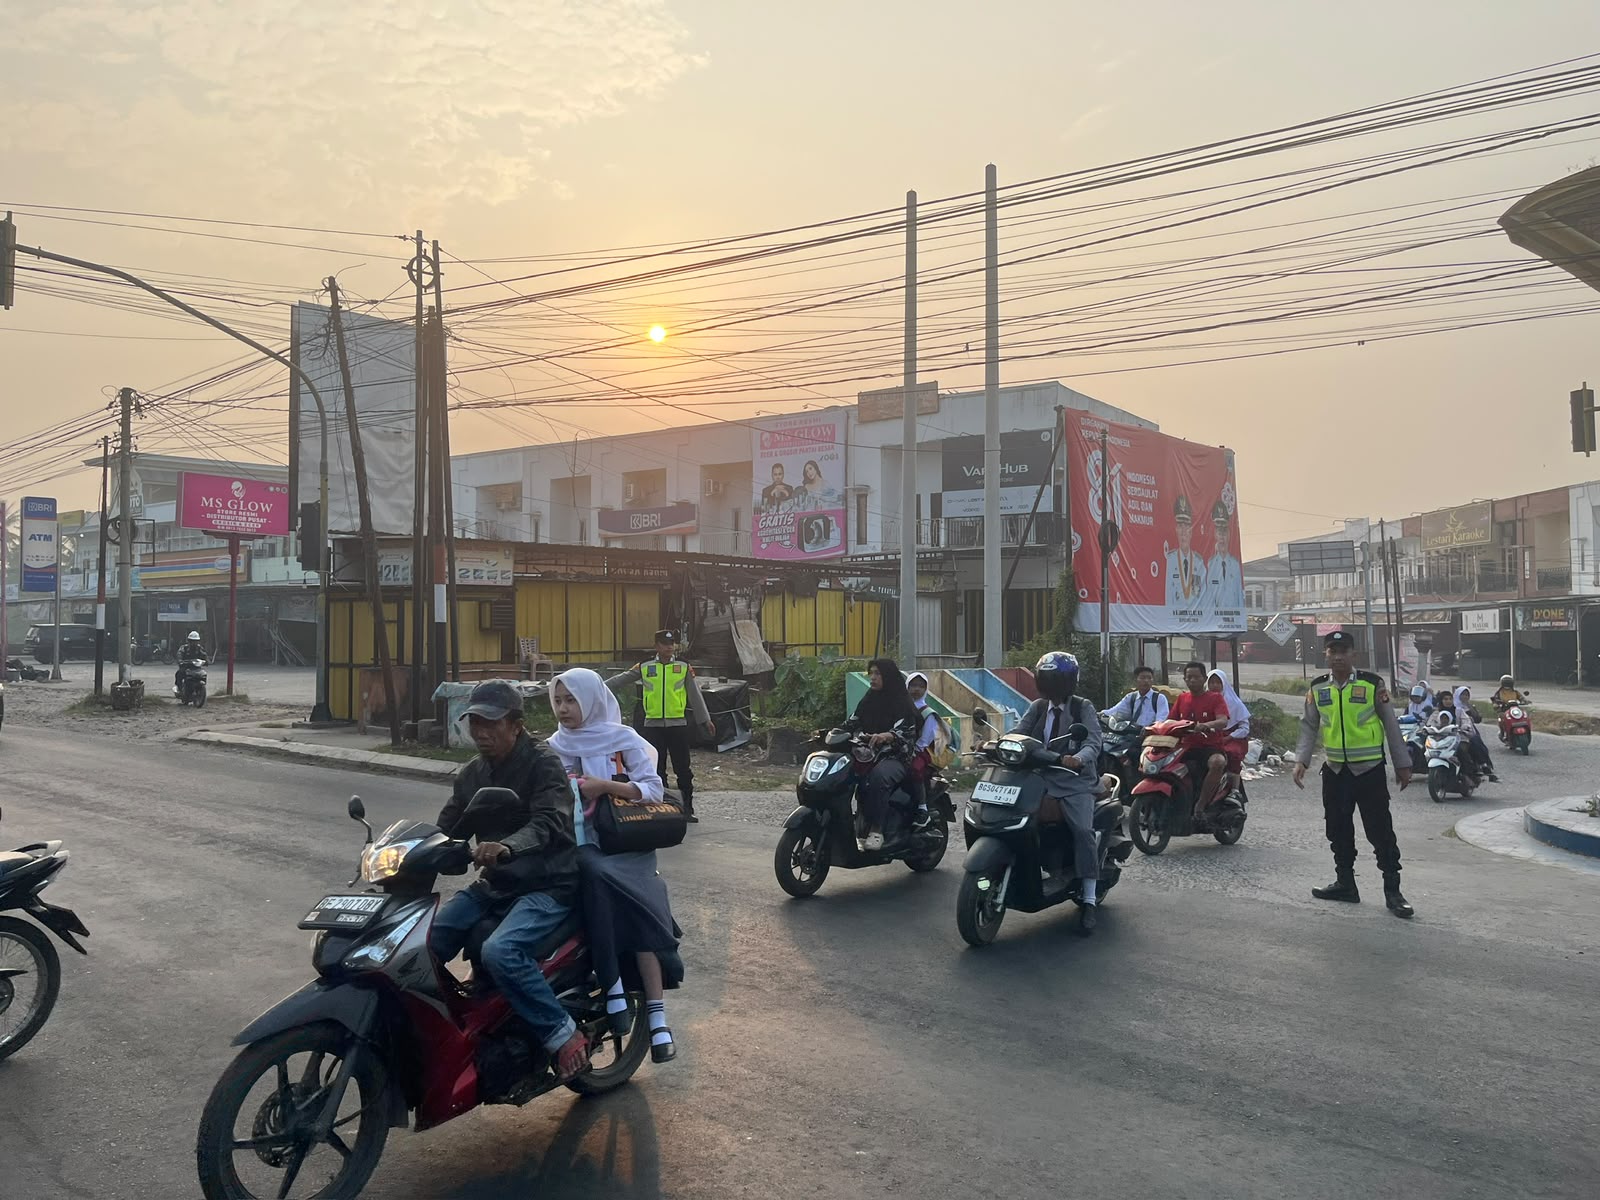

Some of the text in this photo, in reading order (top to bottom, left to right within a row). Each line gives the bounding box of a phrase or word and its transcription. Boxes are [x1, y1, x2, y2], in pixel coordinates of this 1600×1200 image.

[794, 424, 834, 439] GLOW
[1127, 472, 1156, 486] INDONESIA
[1127, 486, 1159, 499] BERDAULAT
[200, 496, 273, 513] MS GLOW
[1128, 499, 1153, 512] ADIL DAN
[206, 513, 268, 525] DISTRIBUTOR PUSAT
[238, 510, 258, 518] RESMI
[759, 512, 795, 529] GRATIS
[1129, 513, 1154, 526] MAKMUR
[28, 533, 53, 542] ATM
[1426, 528, 1485, 546] Lestari Karaoke
[1533, 608, 1565, 619] D'ONE
